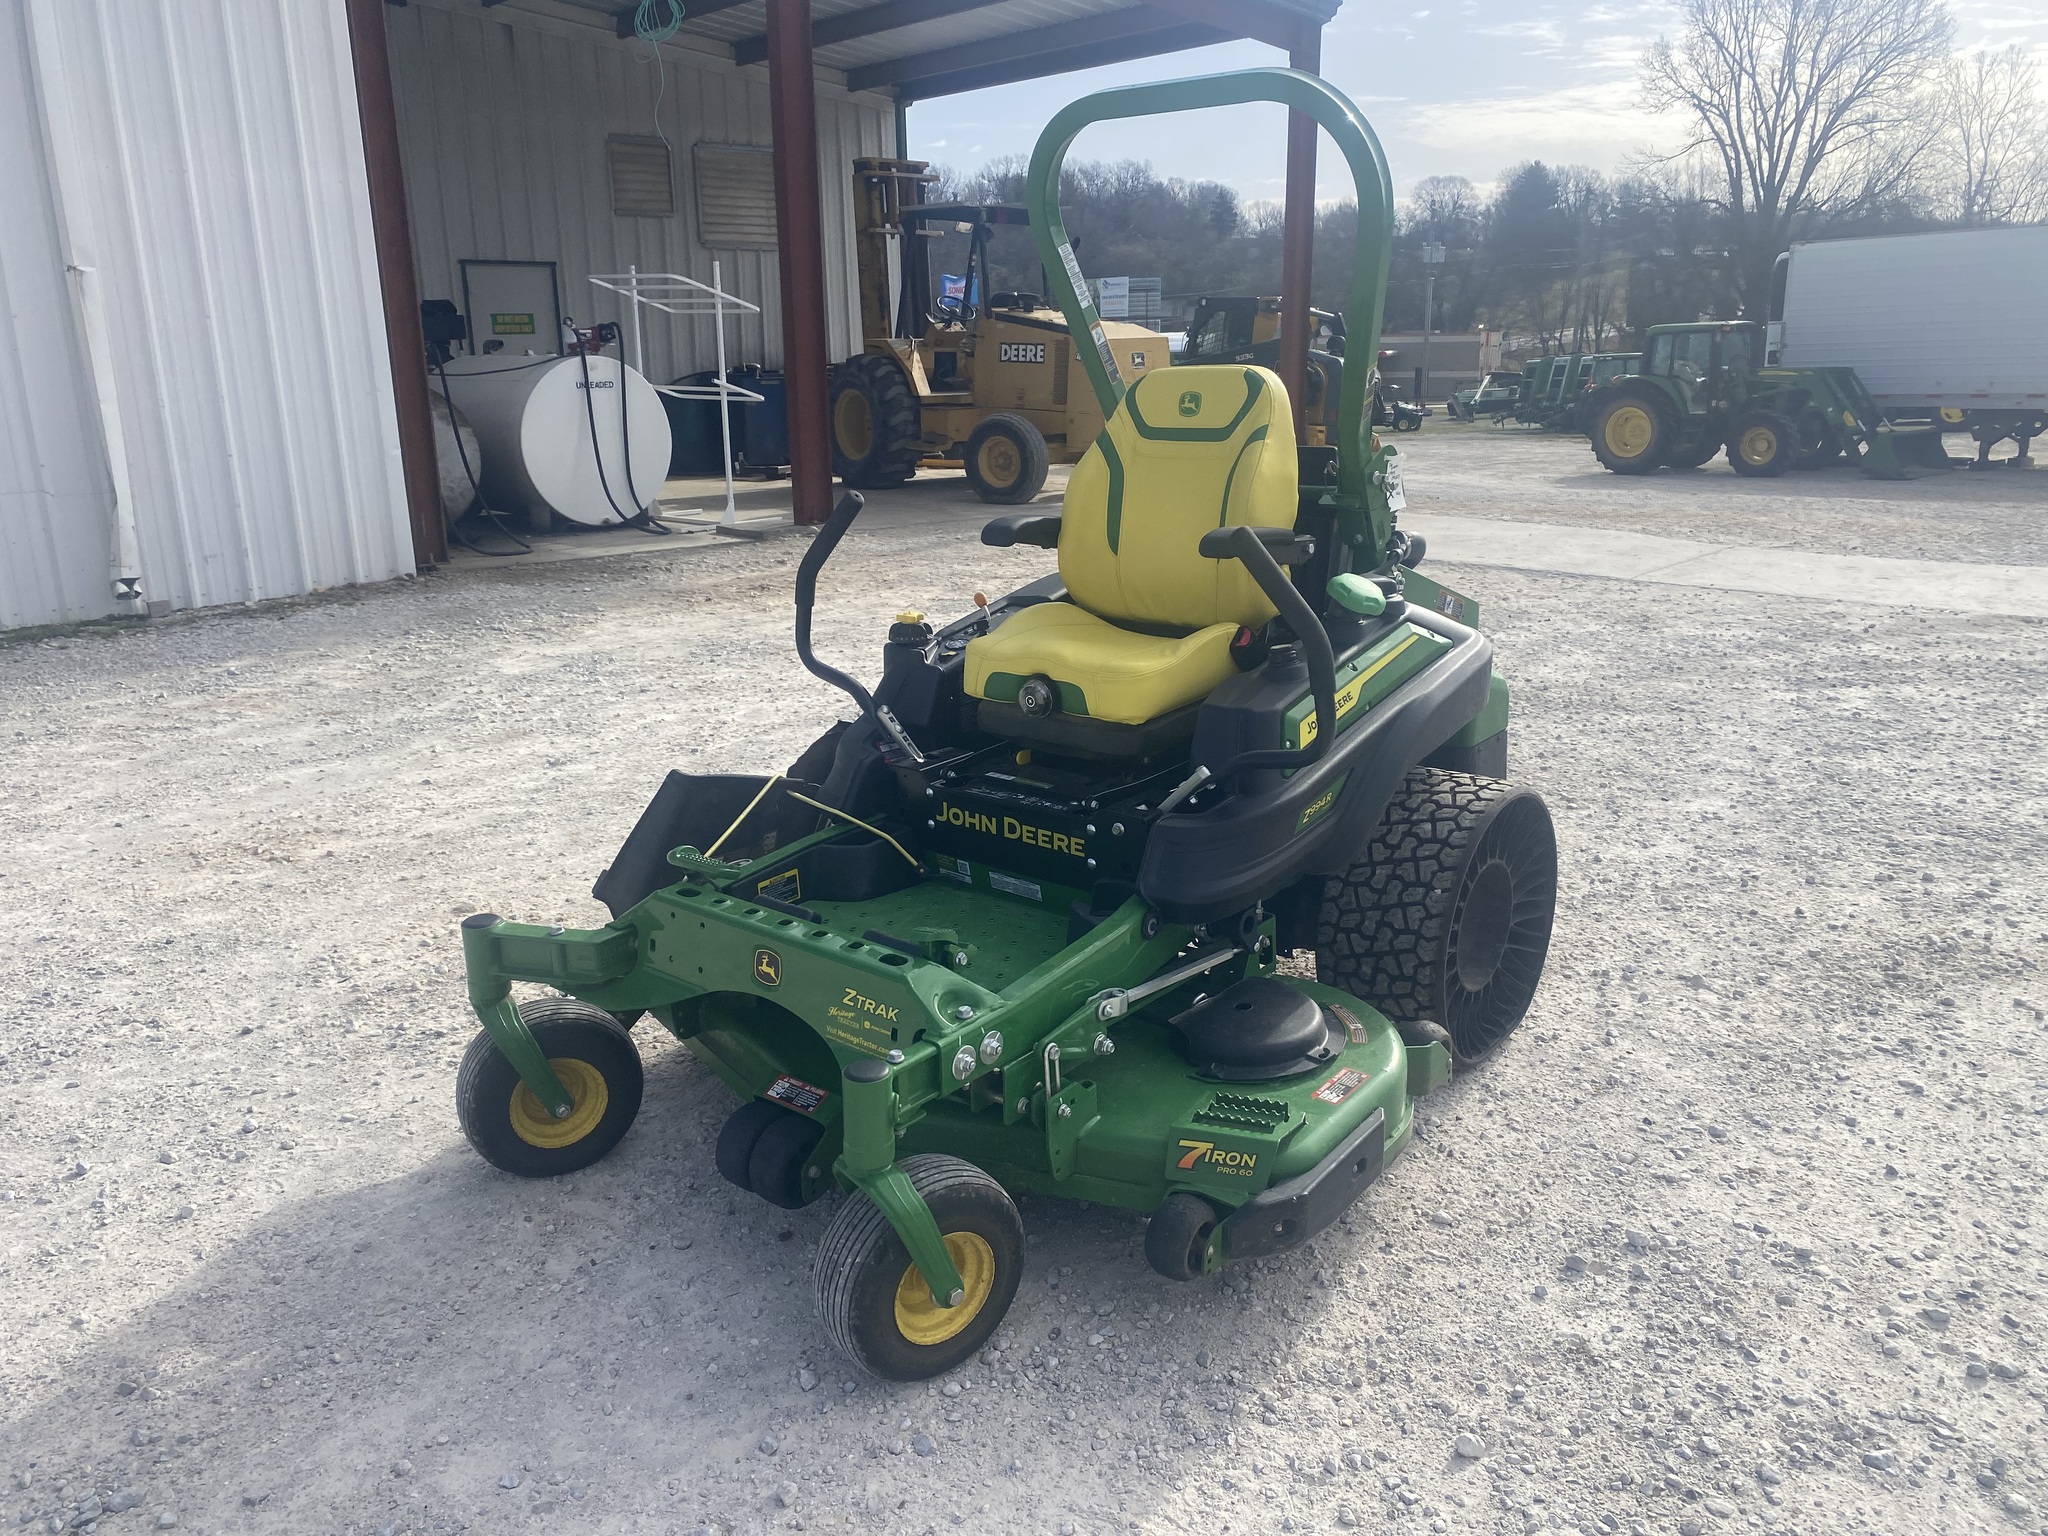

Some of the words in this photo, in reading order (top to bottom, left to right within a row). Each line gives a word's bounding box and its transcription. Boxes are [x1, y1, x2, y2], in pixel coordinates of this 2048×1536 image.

[1001, 344, 1045, 362] DEERE
[576, 381, 614, 389] UNEADED
[1302, 792, 1332, 824] Z994R
[936, 801, 997, 835] JOHN
[1003, 816, 1086, 857] DEERE
[827, 1006, 856, 1019] Heritage
[842, 987, 900, 1022] ZTRAK
[1216, 1166, 1237, 1175] PRO
[1239, 1169, 1253, 1177] 60
